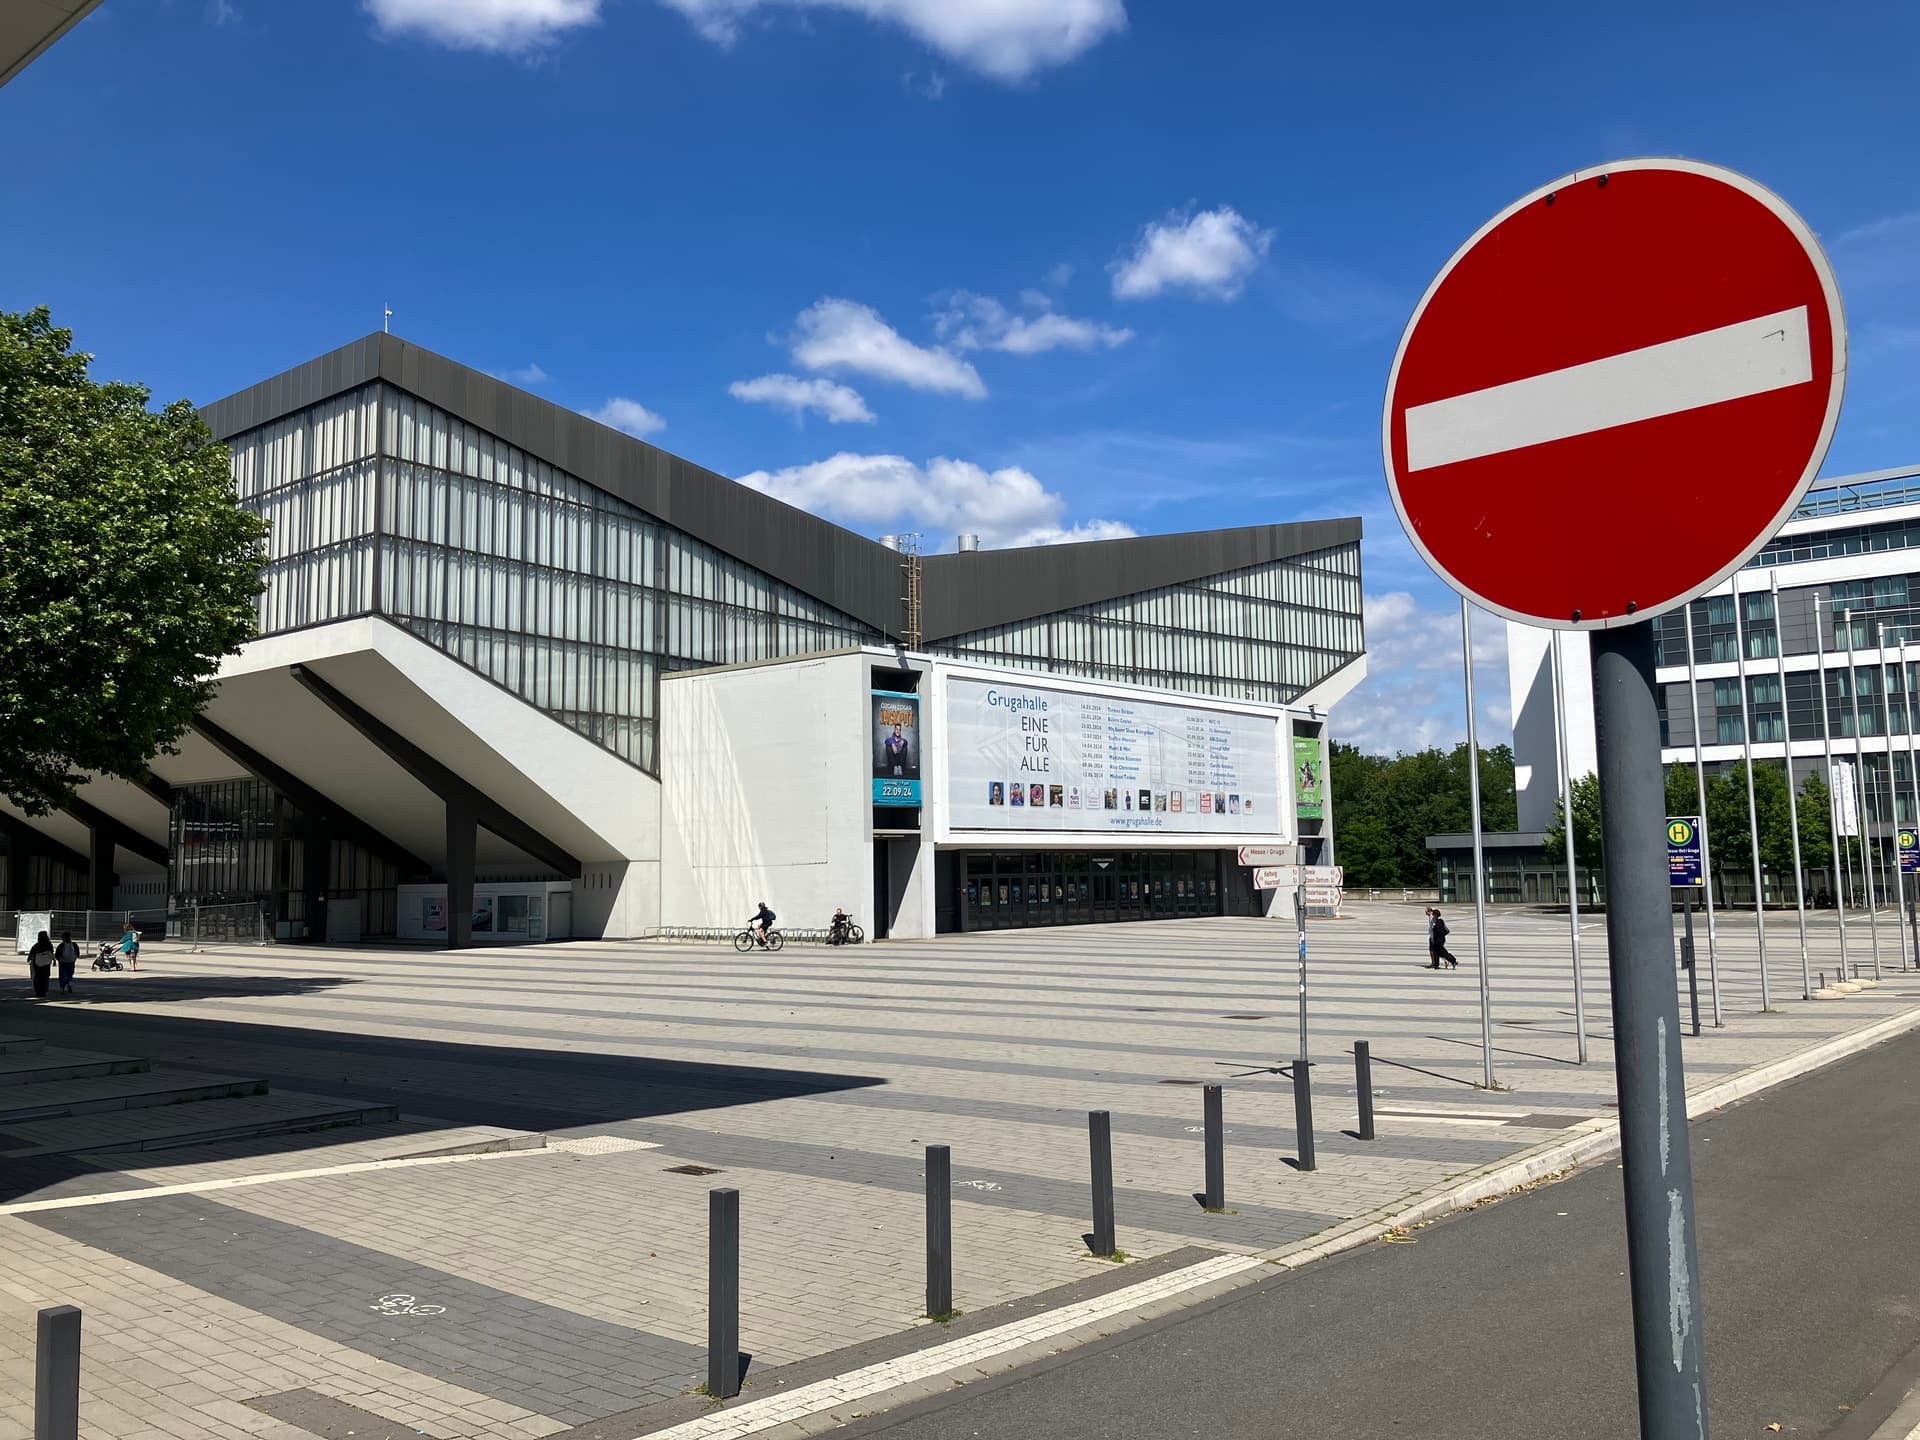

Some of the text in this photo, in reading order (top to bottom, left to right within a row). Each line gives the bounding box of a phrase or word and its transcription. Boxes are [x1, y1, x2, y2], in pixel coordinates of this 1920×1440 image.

[987, 690, 1048, 713] Grugahalle
[1021, 716, 1049, 733] EINE
[1025, 733, 1049, 752] FÜR
[1020, 756, 1050, 772] ALLE
[882, 786, 912, 798] 22.09.24
[1110, 816, 1162, 827] www.grugahalle.de
[1691, 819, 1698, 828] 4
[1673, 826, 1685, 840] H
